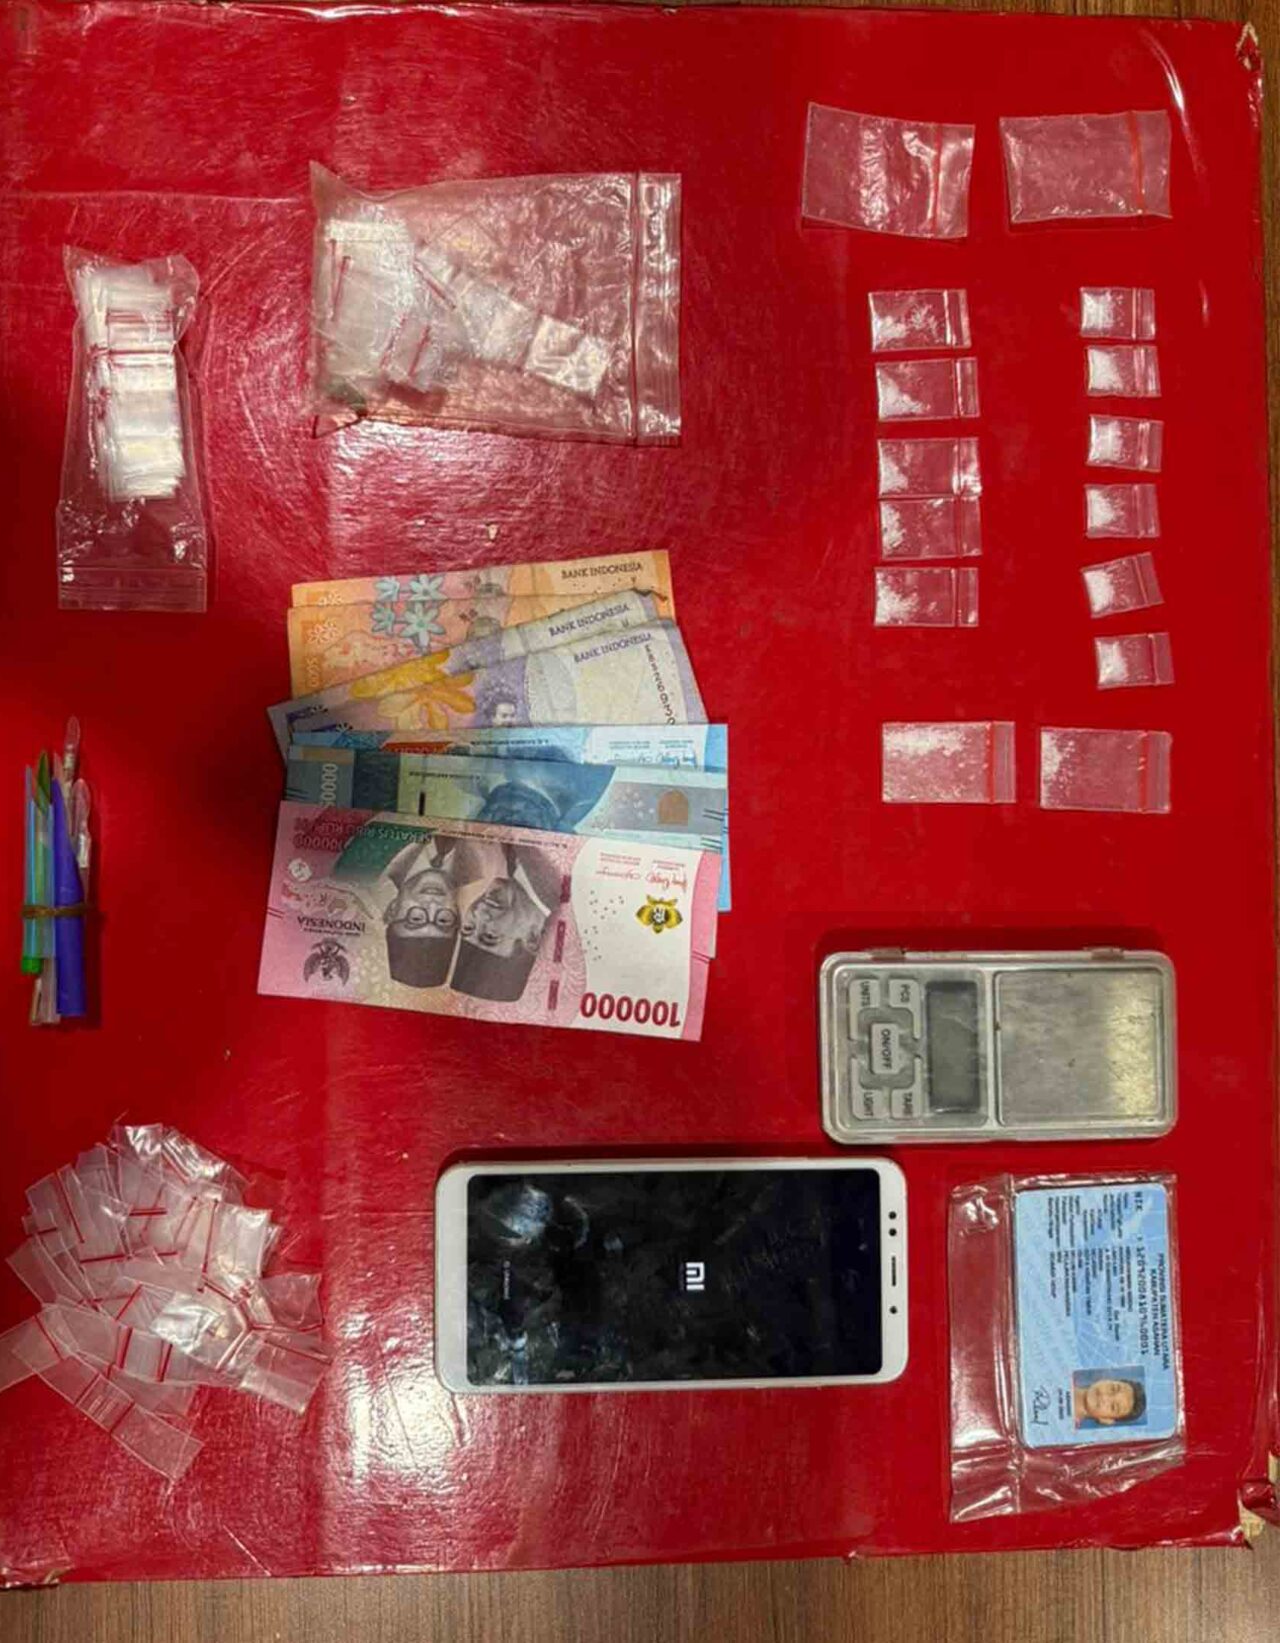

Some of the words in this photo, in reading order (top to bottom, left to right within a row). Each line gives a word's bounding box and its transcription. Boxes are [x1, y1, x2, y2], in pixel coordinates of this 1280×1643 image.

[561, 566, 588, 581] BANK
[590, 561, 644, 577] INDONESIA
[548, 621, 576, 638] BANK
[577, 603, 631, 629] INDONESIA
[573, 647, 601, 663] BANK
[602, 633, 652, 655] INDONESIA
[297, 915, 365, 934] INDONESIA
[580, 992, 681, 1028] 100000
[881, 1028, 892, 1070] ON/OFF
